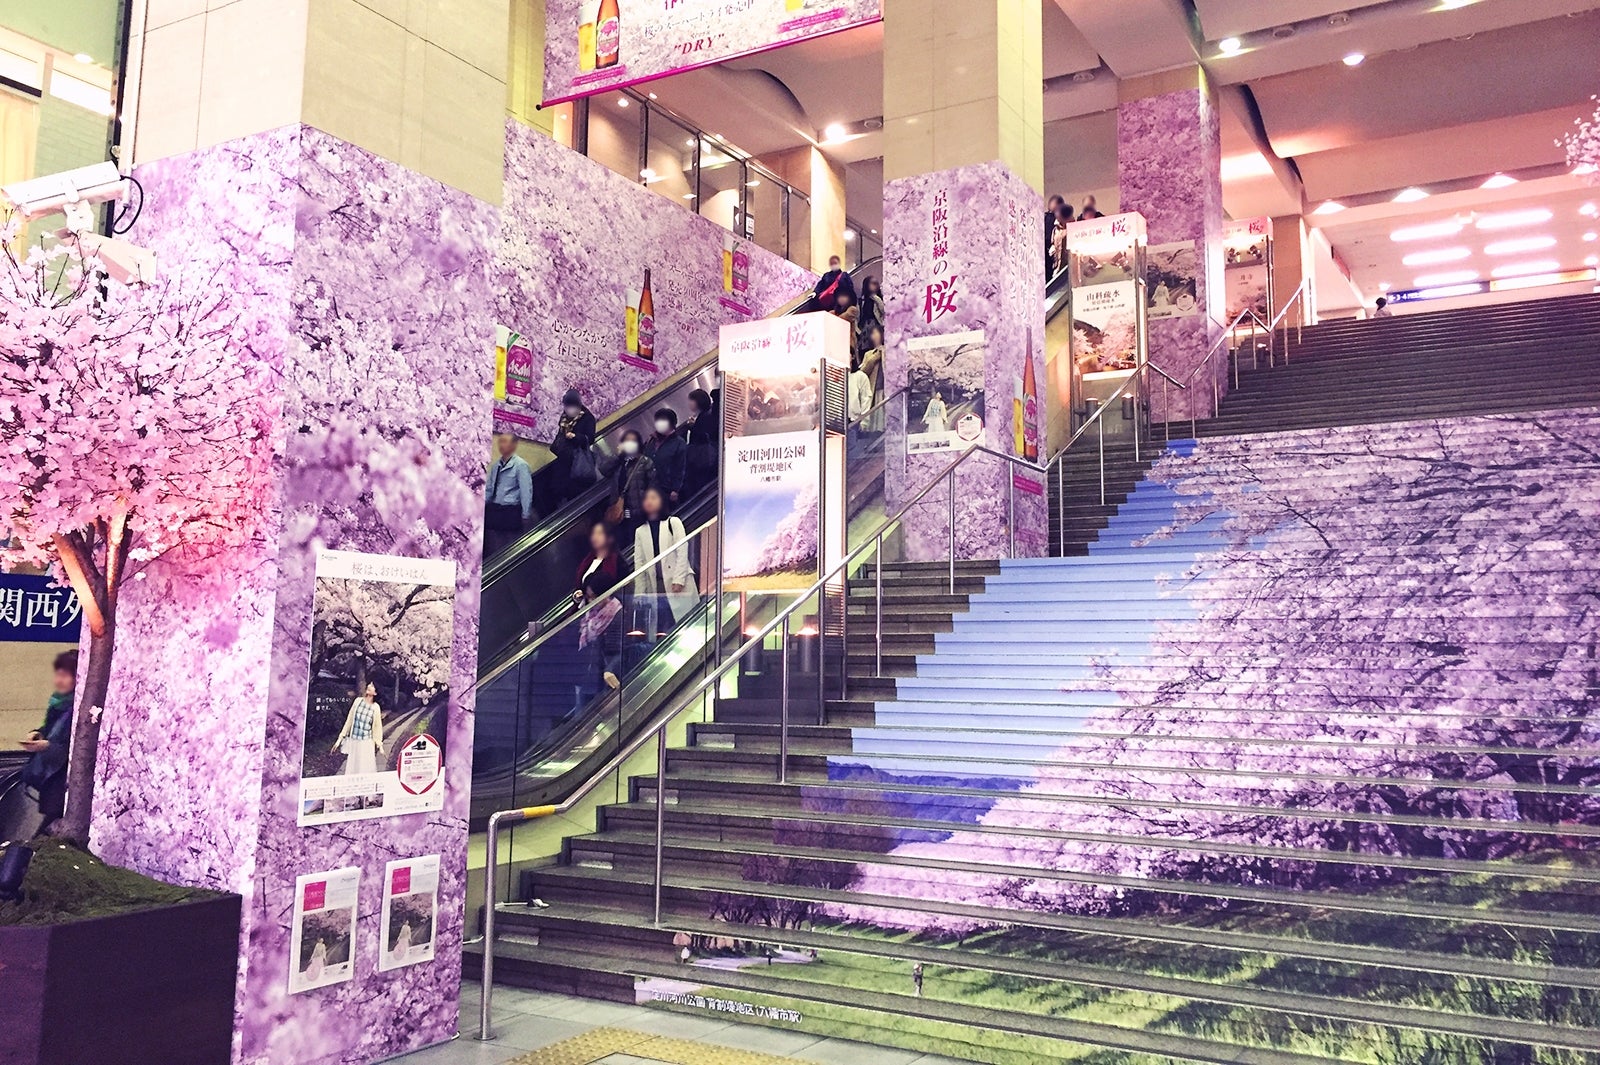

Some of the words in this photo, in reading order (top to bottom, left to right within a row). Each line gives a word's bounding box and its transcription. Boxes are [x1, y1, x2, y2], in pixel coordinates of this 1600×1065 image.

[1111, 217, 1126, 237] 桜
[786, 320, 808, 354] 桜
[737, 445, 806, 463] 淀川河川公園
